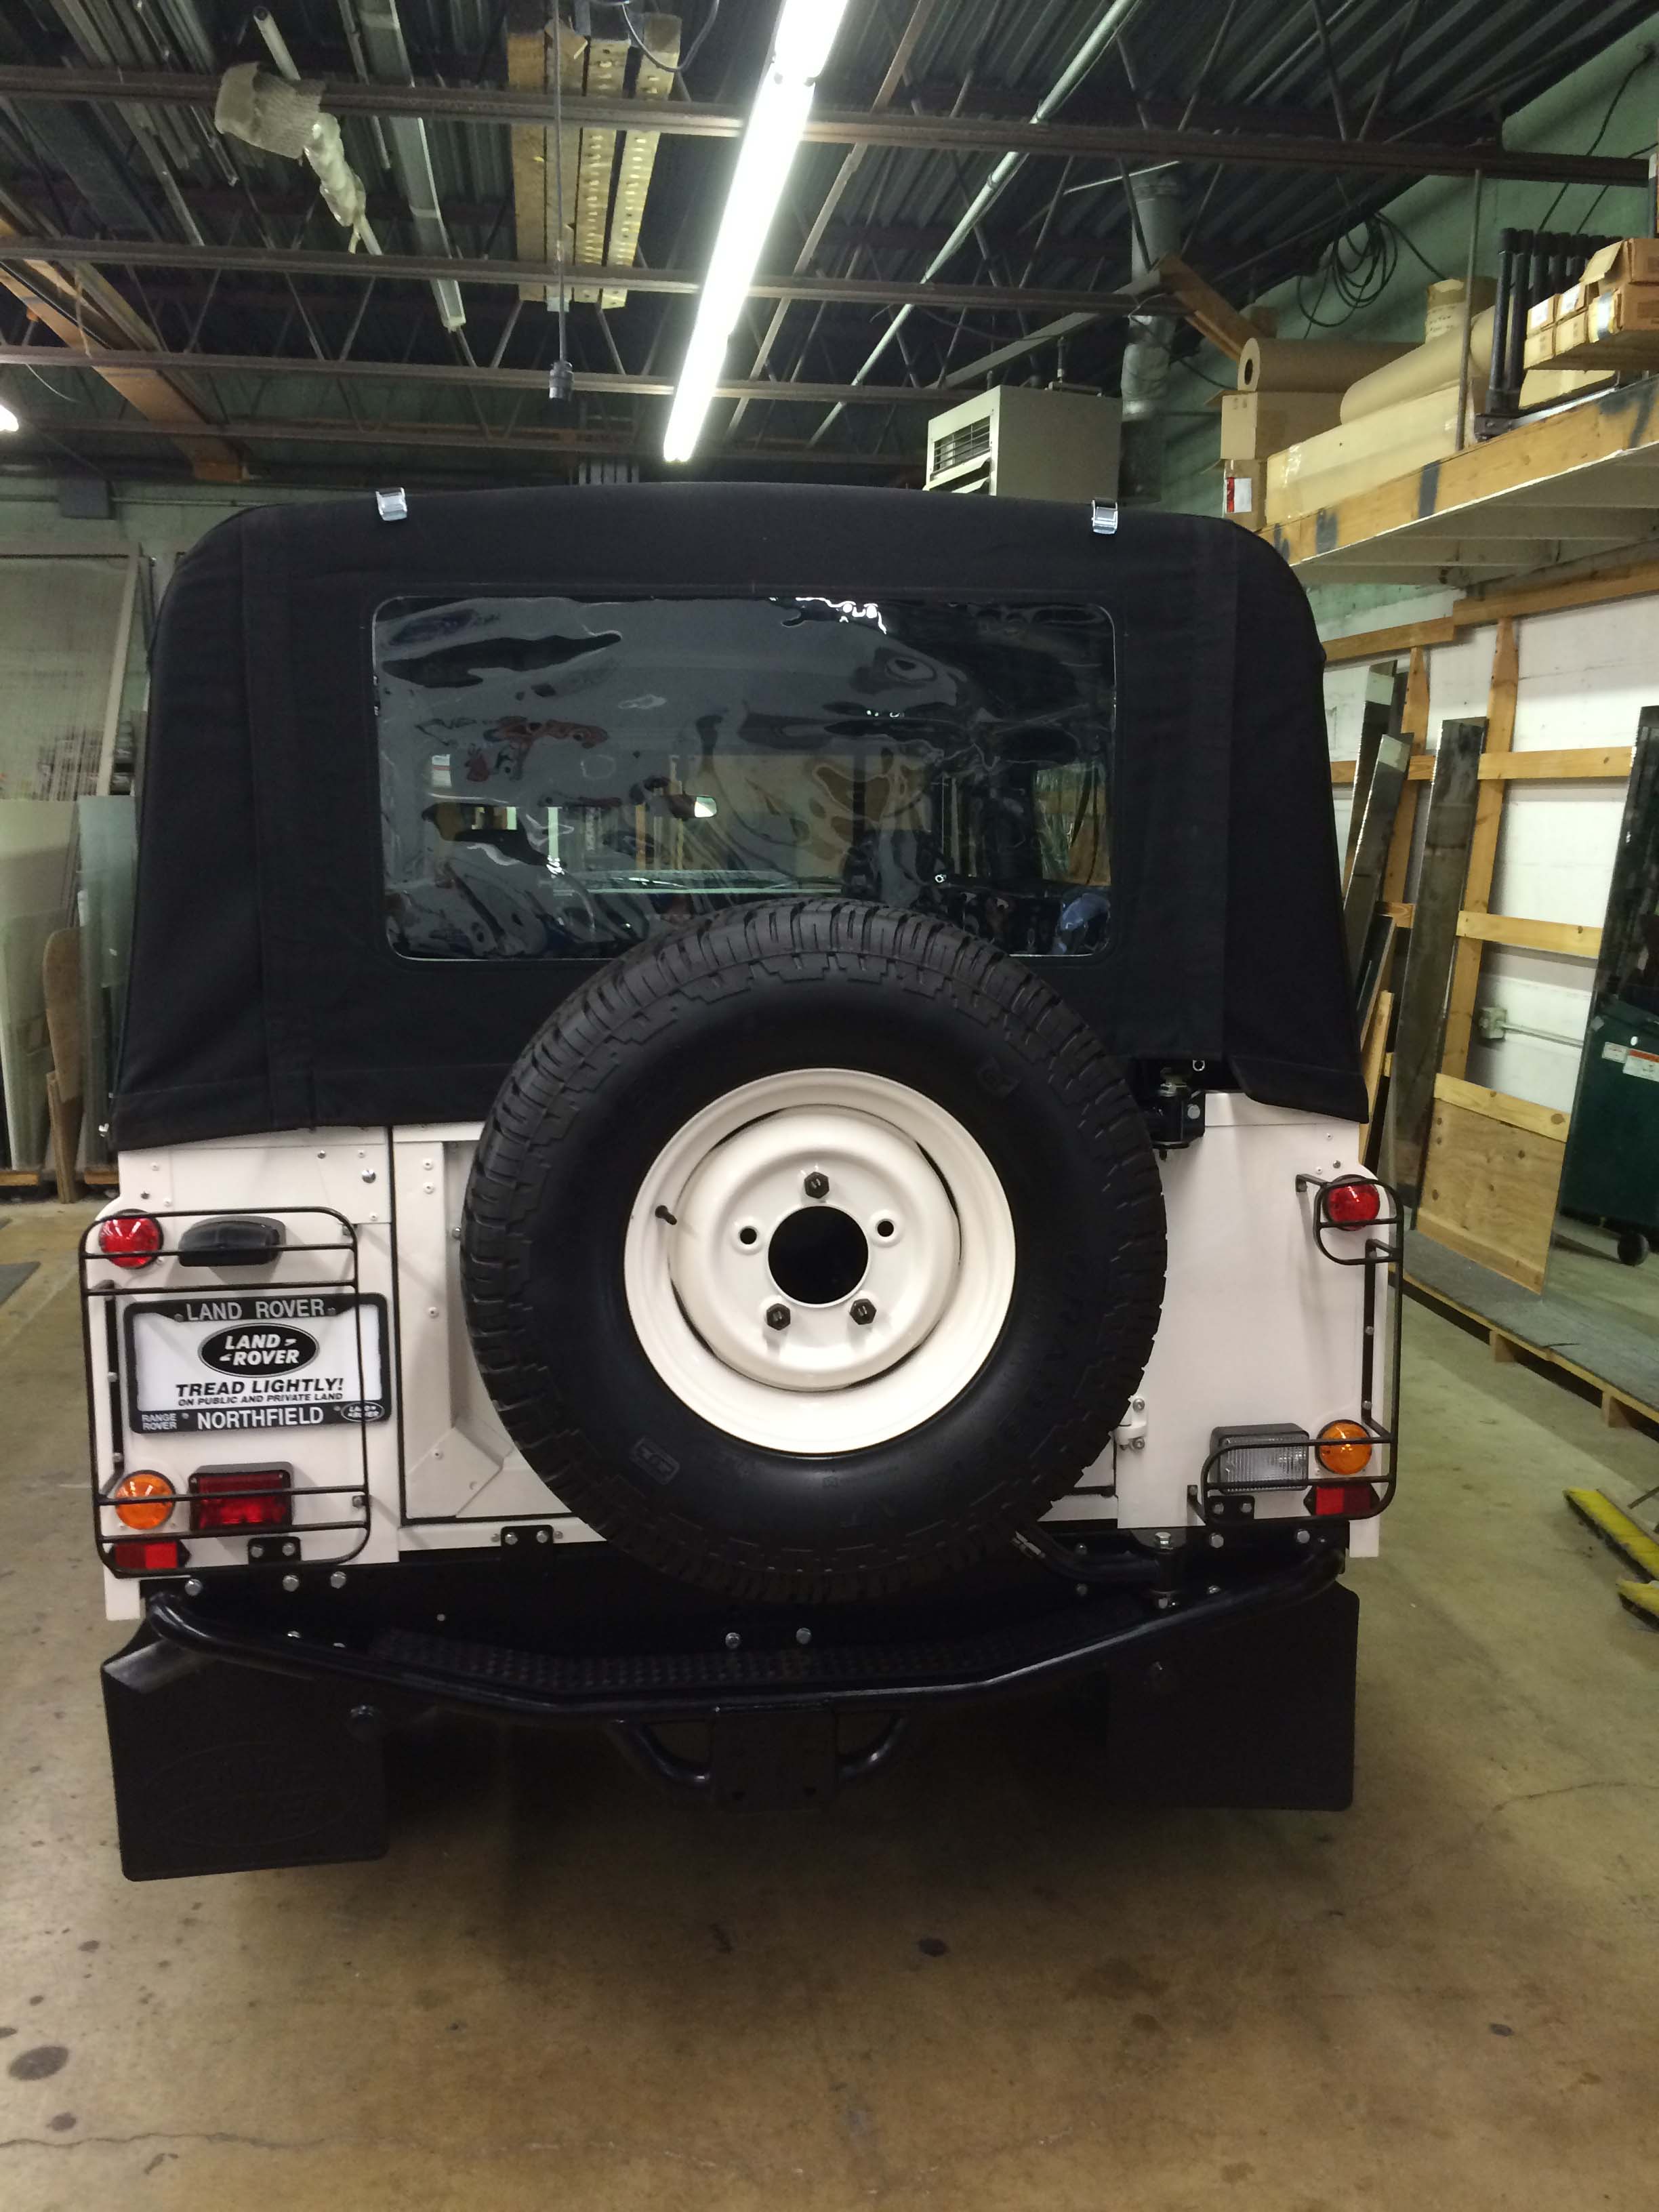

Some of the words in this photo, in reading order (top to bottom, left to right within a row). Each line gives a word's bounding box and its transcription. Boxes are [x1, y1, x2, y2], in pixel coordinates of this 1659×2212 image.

[186, 1302, 243, 1321] LAND
[255, 1298, 325, 1318] ROVER
[225, 1334, 281, 1349] LAND
[232, 1349, 300, 1366] ROVER
[176, 1381, 245, 1397] TREAD
[251, 1378, 344, 1394] LIGHTLY!
[178, 1398, 194, 1406] ON
[198, 1396, 237, 1405] PUBLIC
[241, 1395, 264, 1403] AND
[266, 1393, 310, 1402] PRIVATE
[314, 1393, 343, 1401] LAND
[142, 1413, 177, 1422] RANGE
[197, 1406, 324, 1430] NORTHFIELD
[142, 1422, 178, 1431] ROVER
